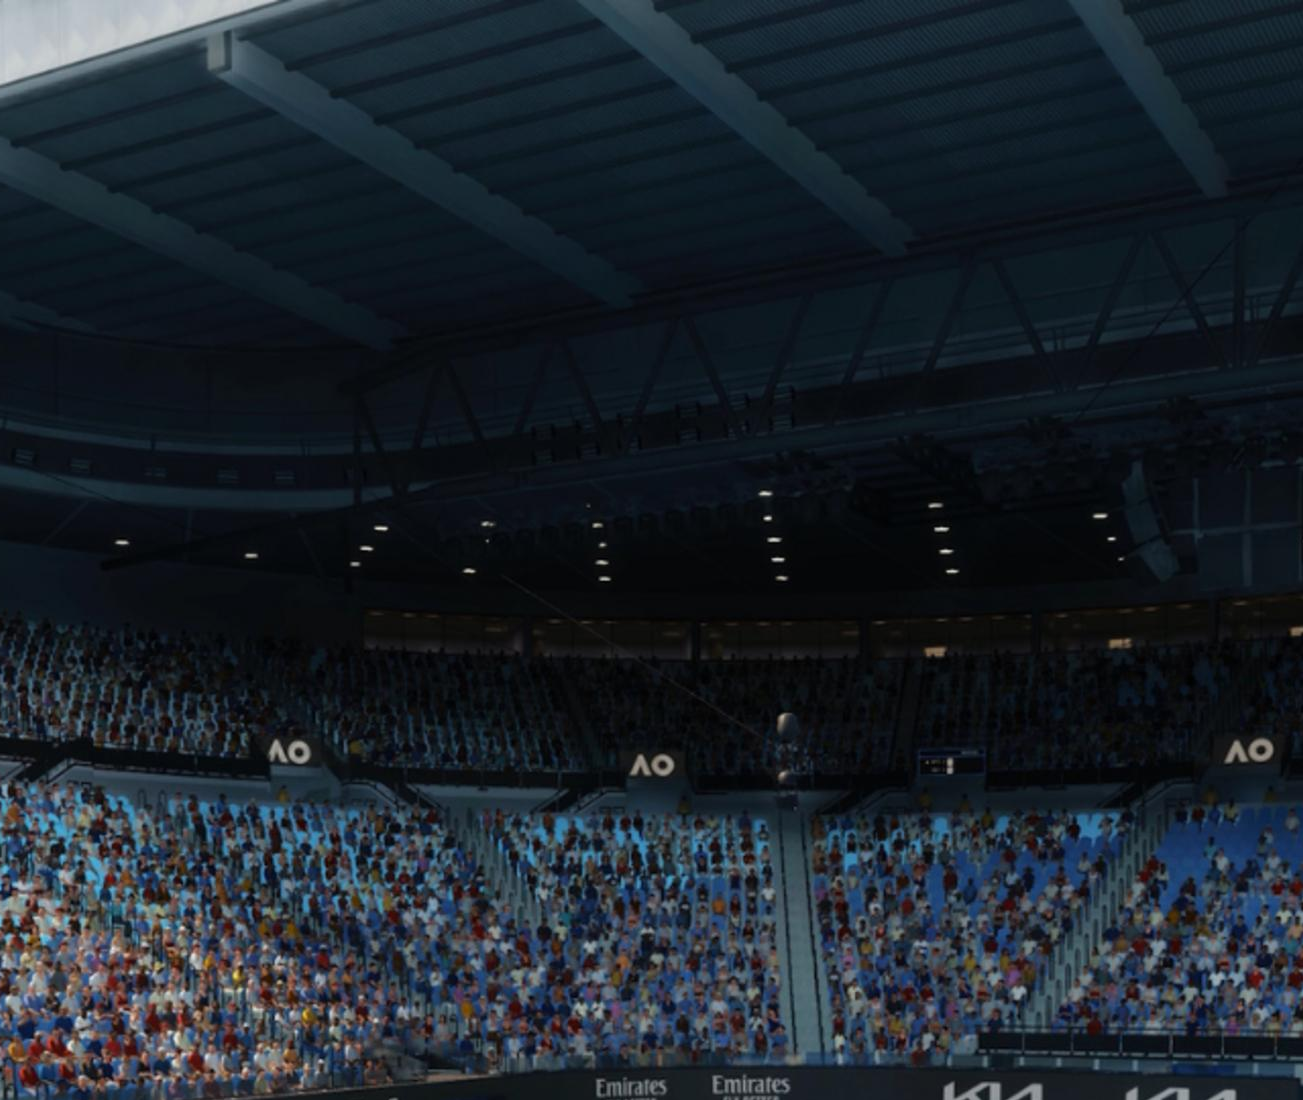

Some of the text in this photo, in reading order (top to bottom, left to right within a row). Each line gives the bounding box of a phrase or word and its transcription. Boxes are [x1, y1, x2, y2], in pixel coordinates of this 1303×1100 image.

[269, 739, 311, 765] AO
[1224, 738, 1274, 763] AO
[629, 754, 675, 777] AO
[596, 1077, 667, 1098] Emirates
[712, 1074, 791, 1094] Emirates
